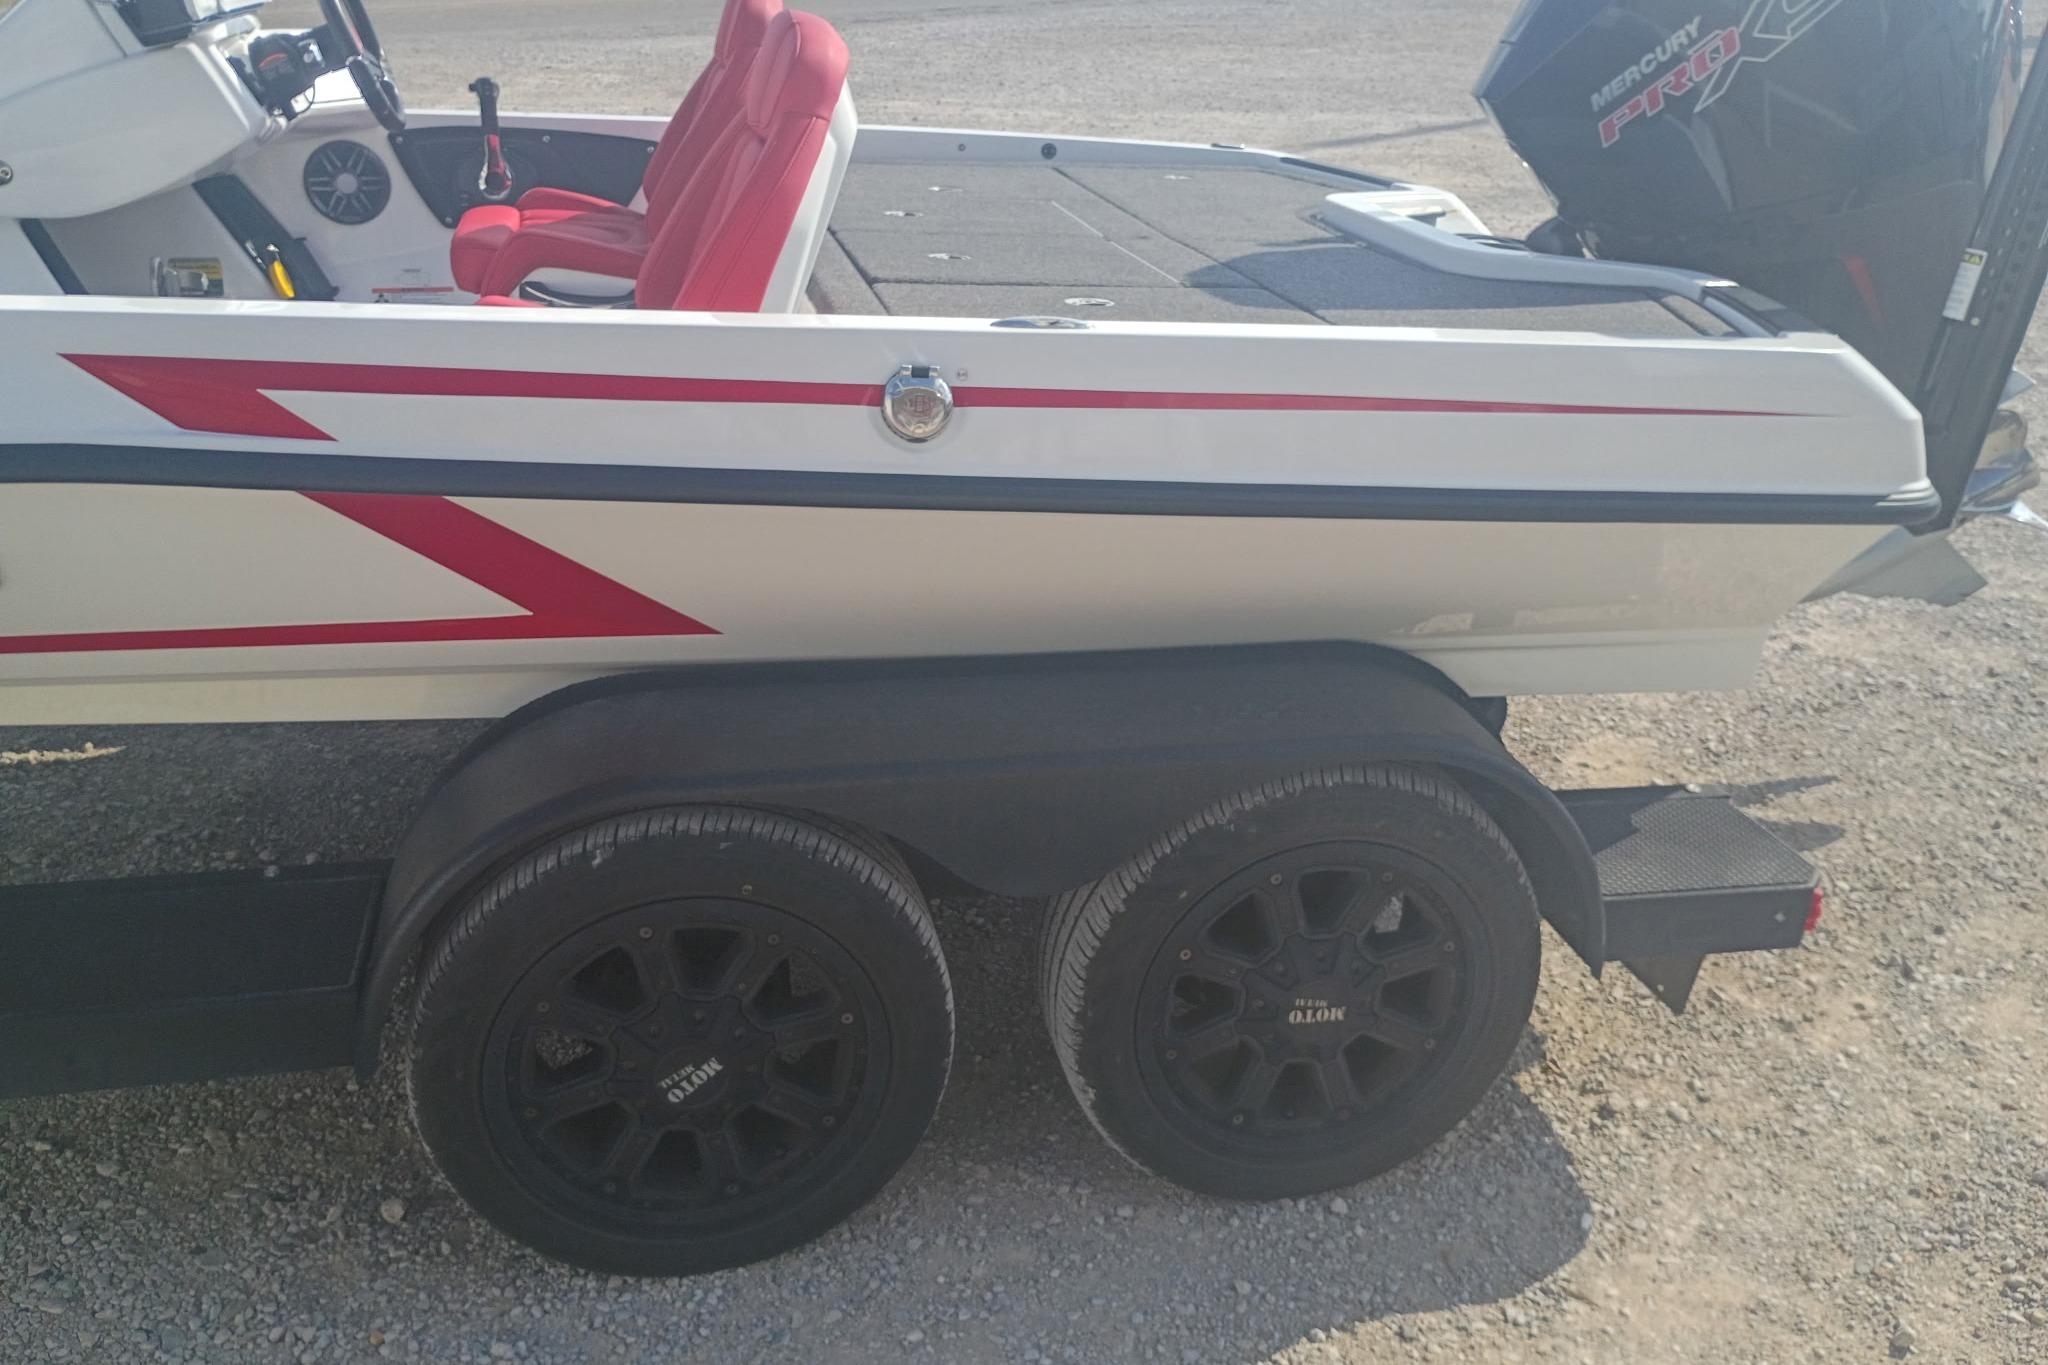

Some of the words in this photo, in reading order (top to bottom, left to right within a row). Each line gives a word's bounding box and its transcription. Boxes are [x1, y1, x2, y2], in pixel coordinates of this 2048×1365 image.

[1591, 15, 1701, 112] MERCURY
[1598, 27, 1741, 148] PRO
[1288, 1007, 1346, 1024] MOTO
[667, 1057, 724, 1103] MOTO
